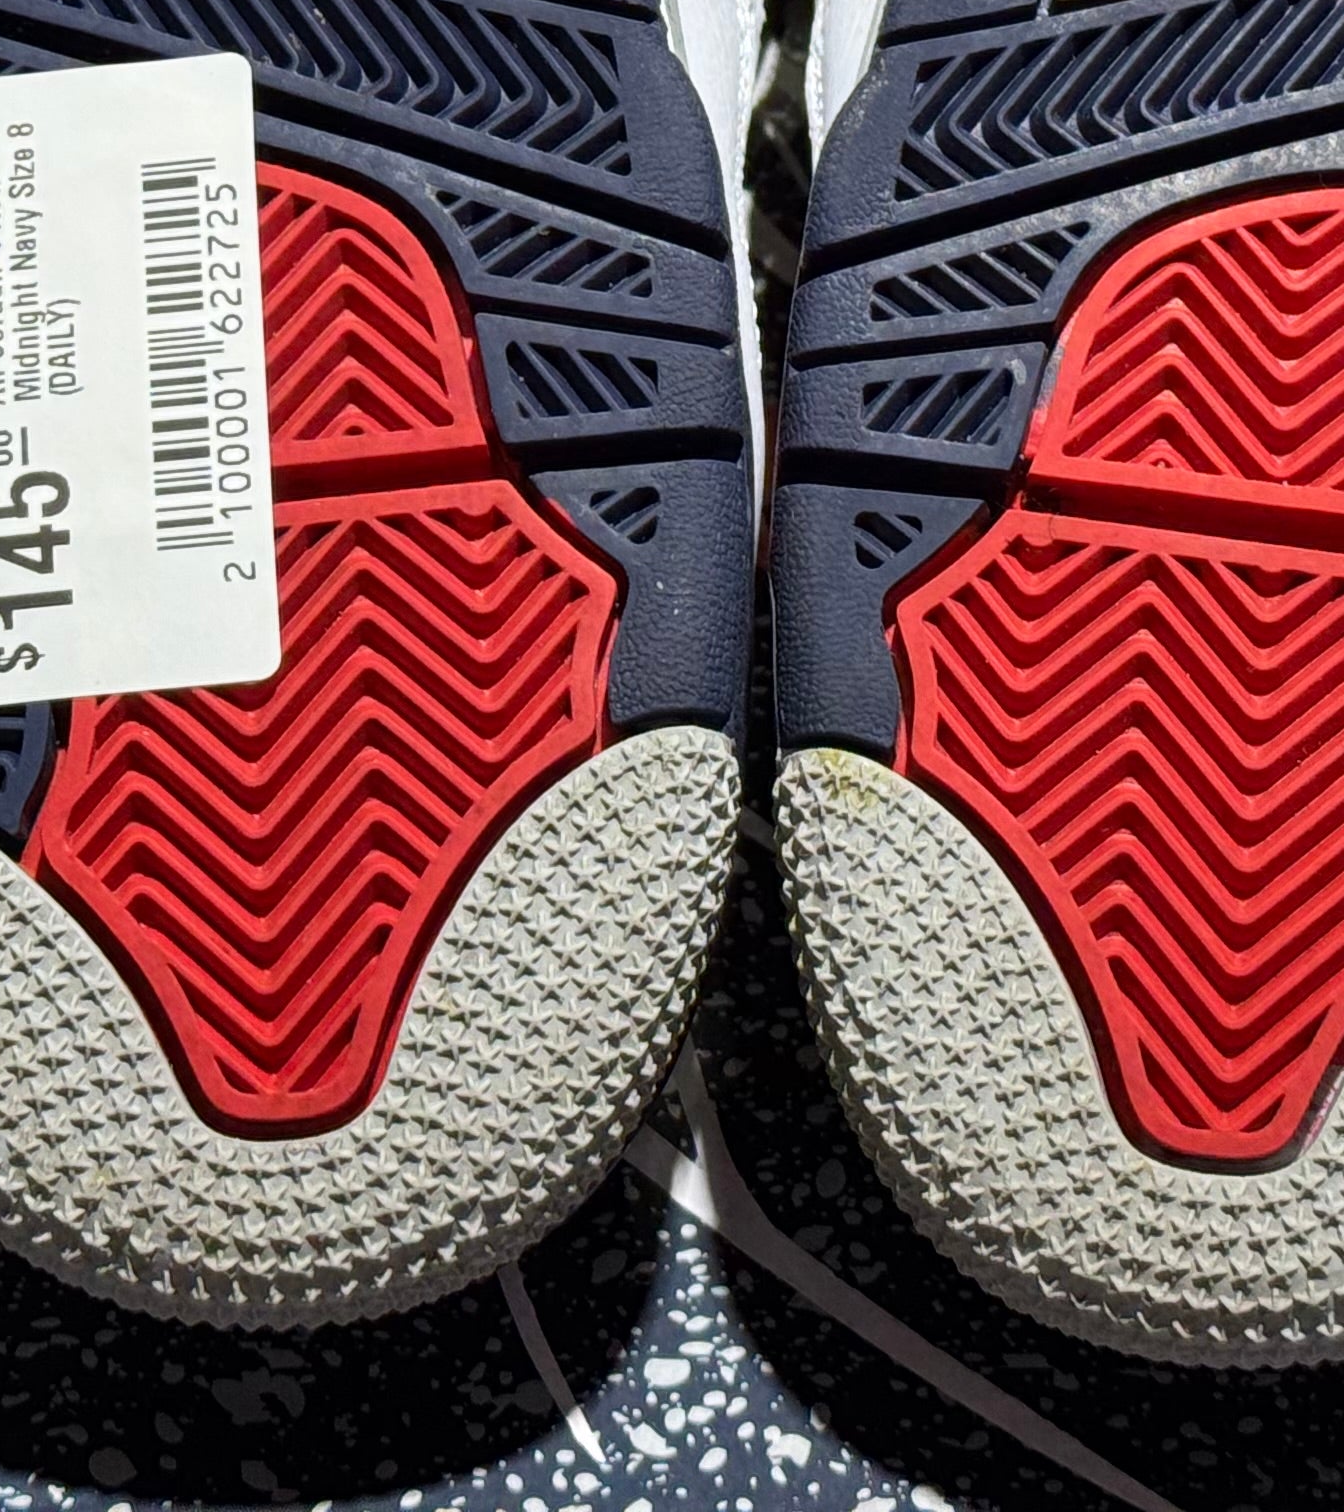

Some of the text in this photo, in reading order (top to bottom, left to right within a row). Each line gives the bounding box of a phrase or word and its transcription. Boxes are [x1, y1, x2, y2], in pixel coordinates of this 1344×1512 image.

[6, 123, 47, 402] Midnight Navy Size 8
[45, 298, 85, 396] (DAILY)
[205, 184, 257, 582] 2 100001 622725
